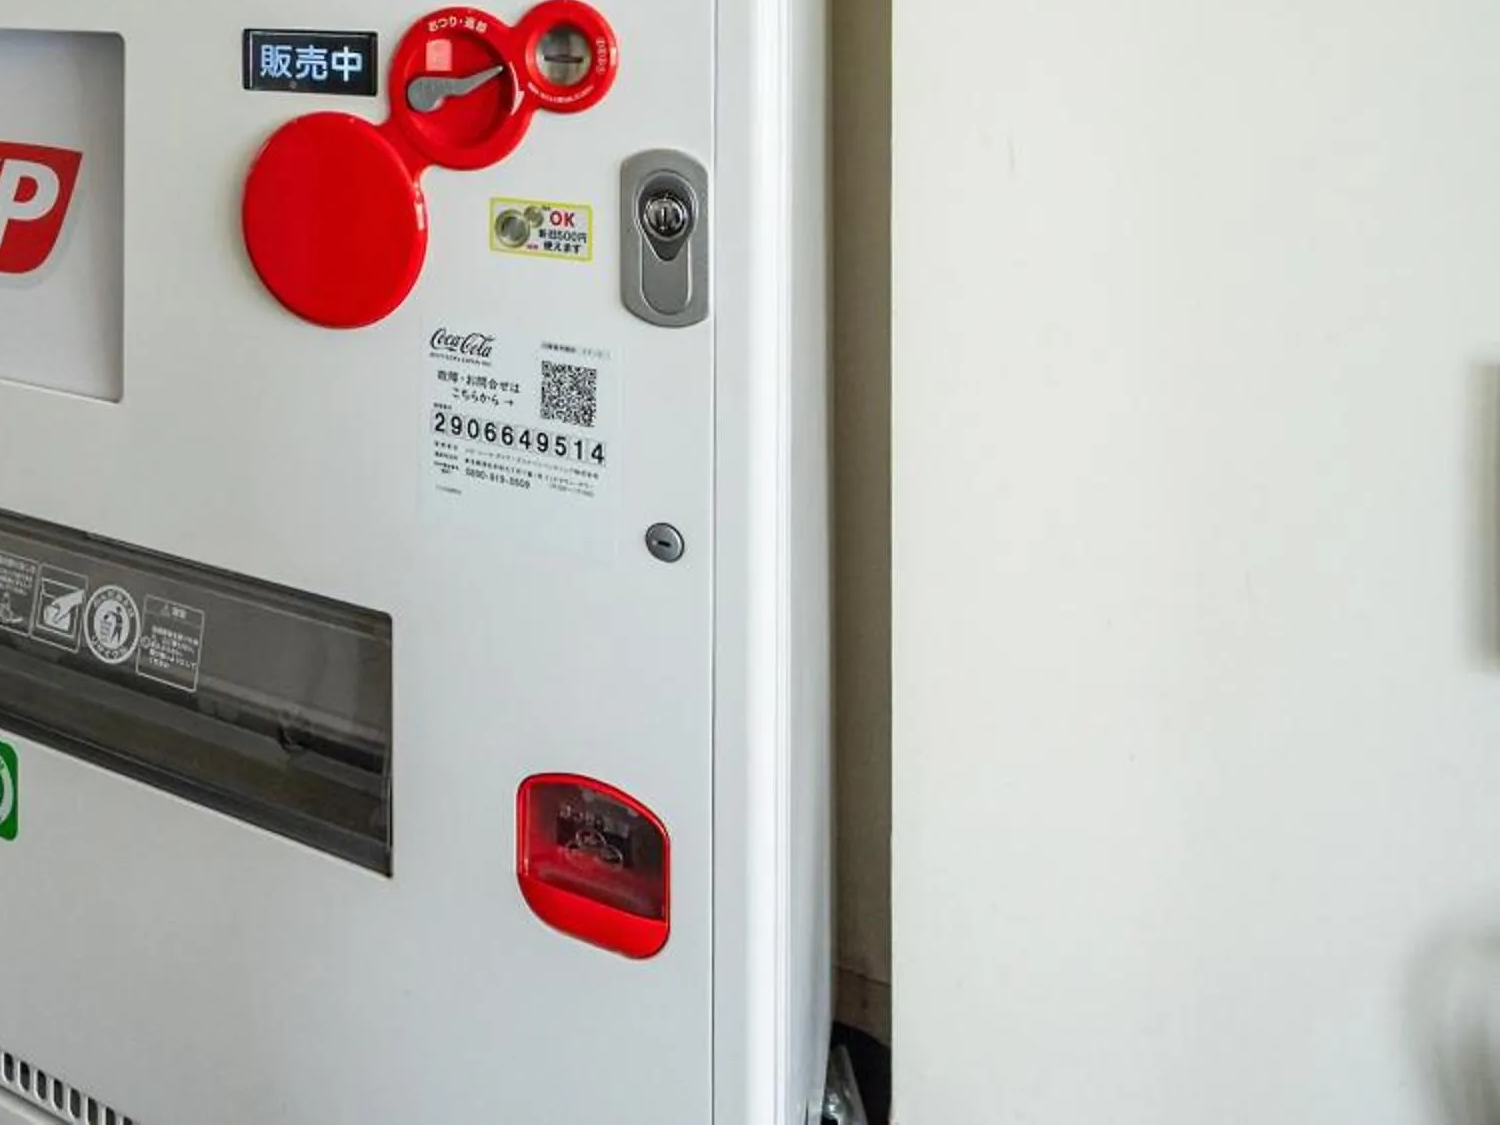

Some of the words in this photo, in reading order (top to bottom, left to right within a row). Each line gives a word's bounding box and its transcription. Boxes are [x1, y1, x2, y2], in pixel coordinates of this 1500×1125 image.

[259, 43, 363, 82] 販売中
[549, 211, 576, 227] OK
[543, 242, 582, 255] 使えます
[452, 387, 500, 406] こちらから
[434, 411, 605, 464] 2906649514
